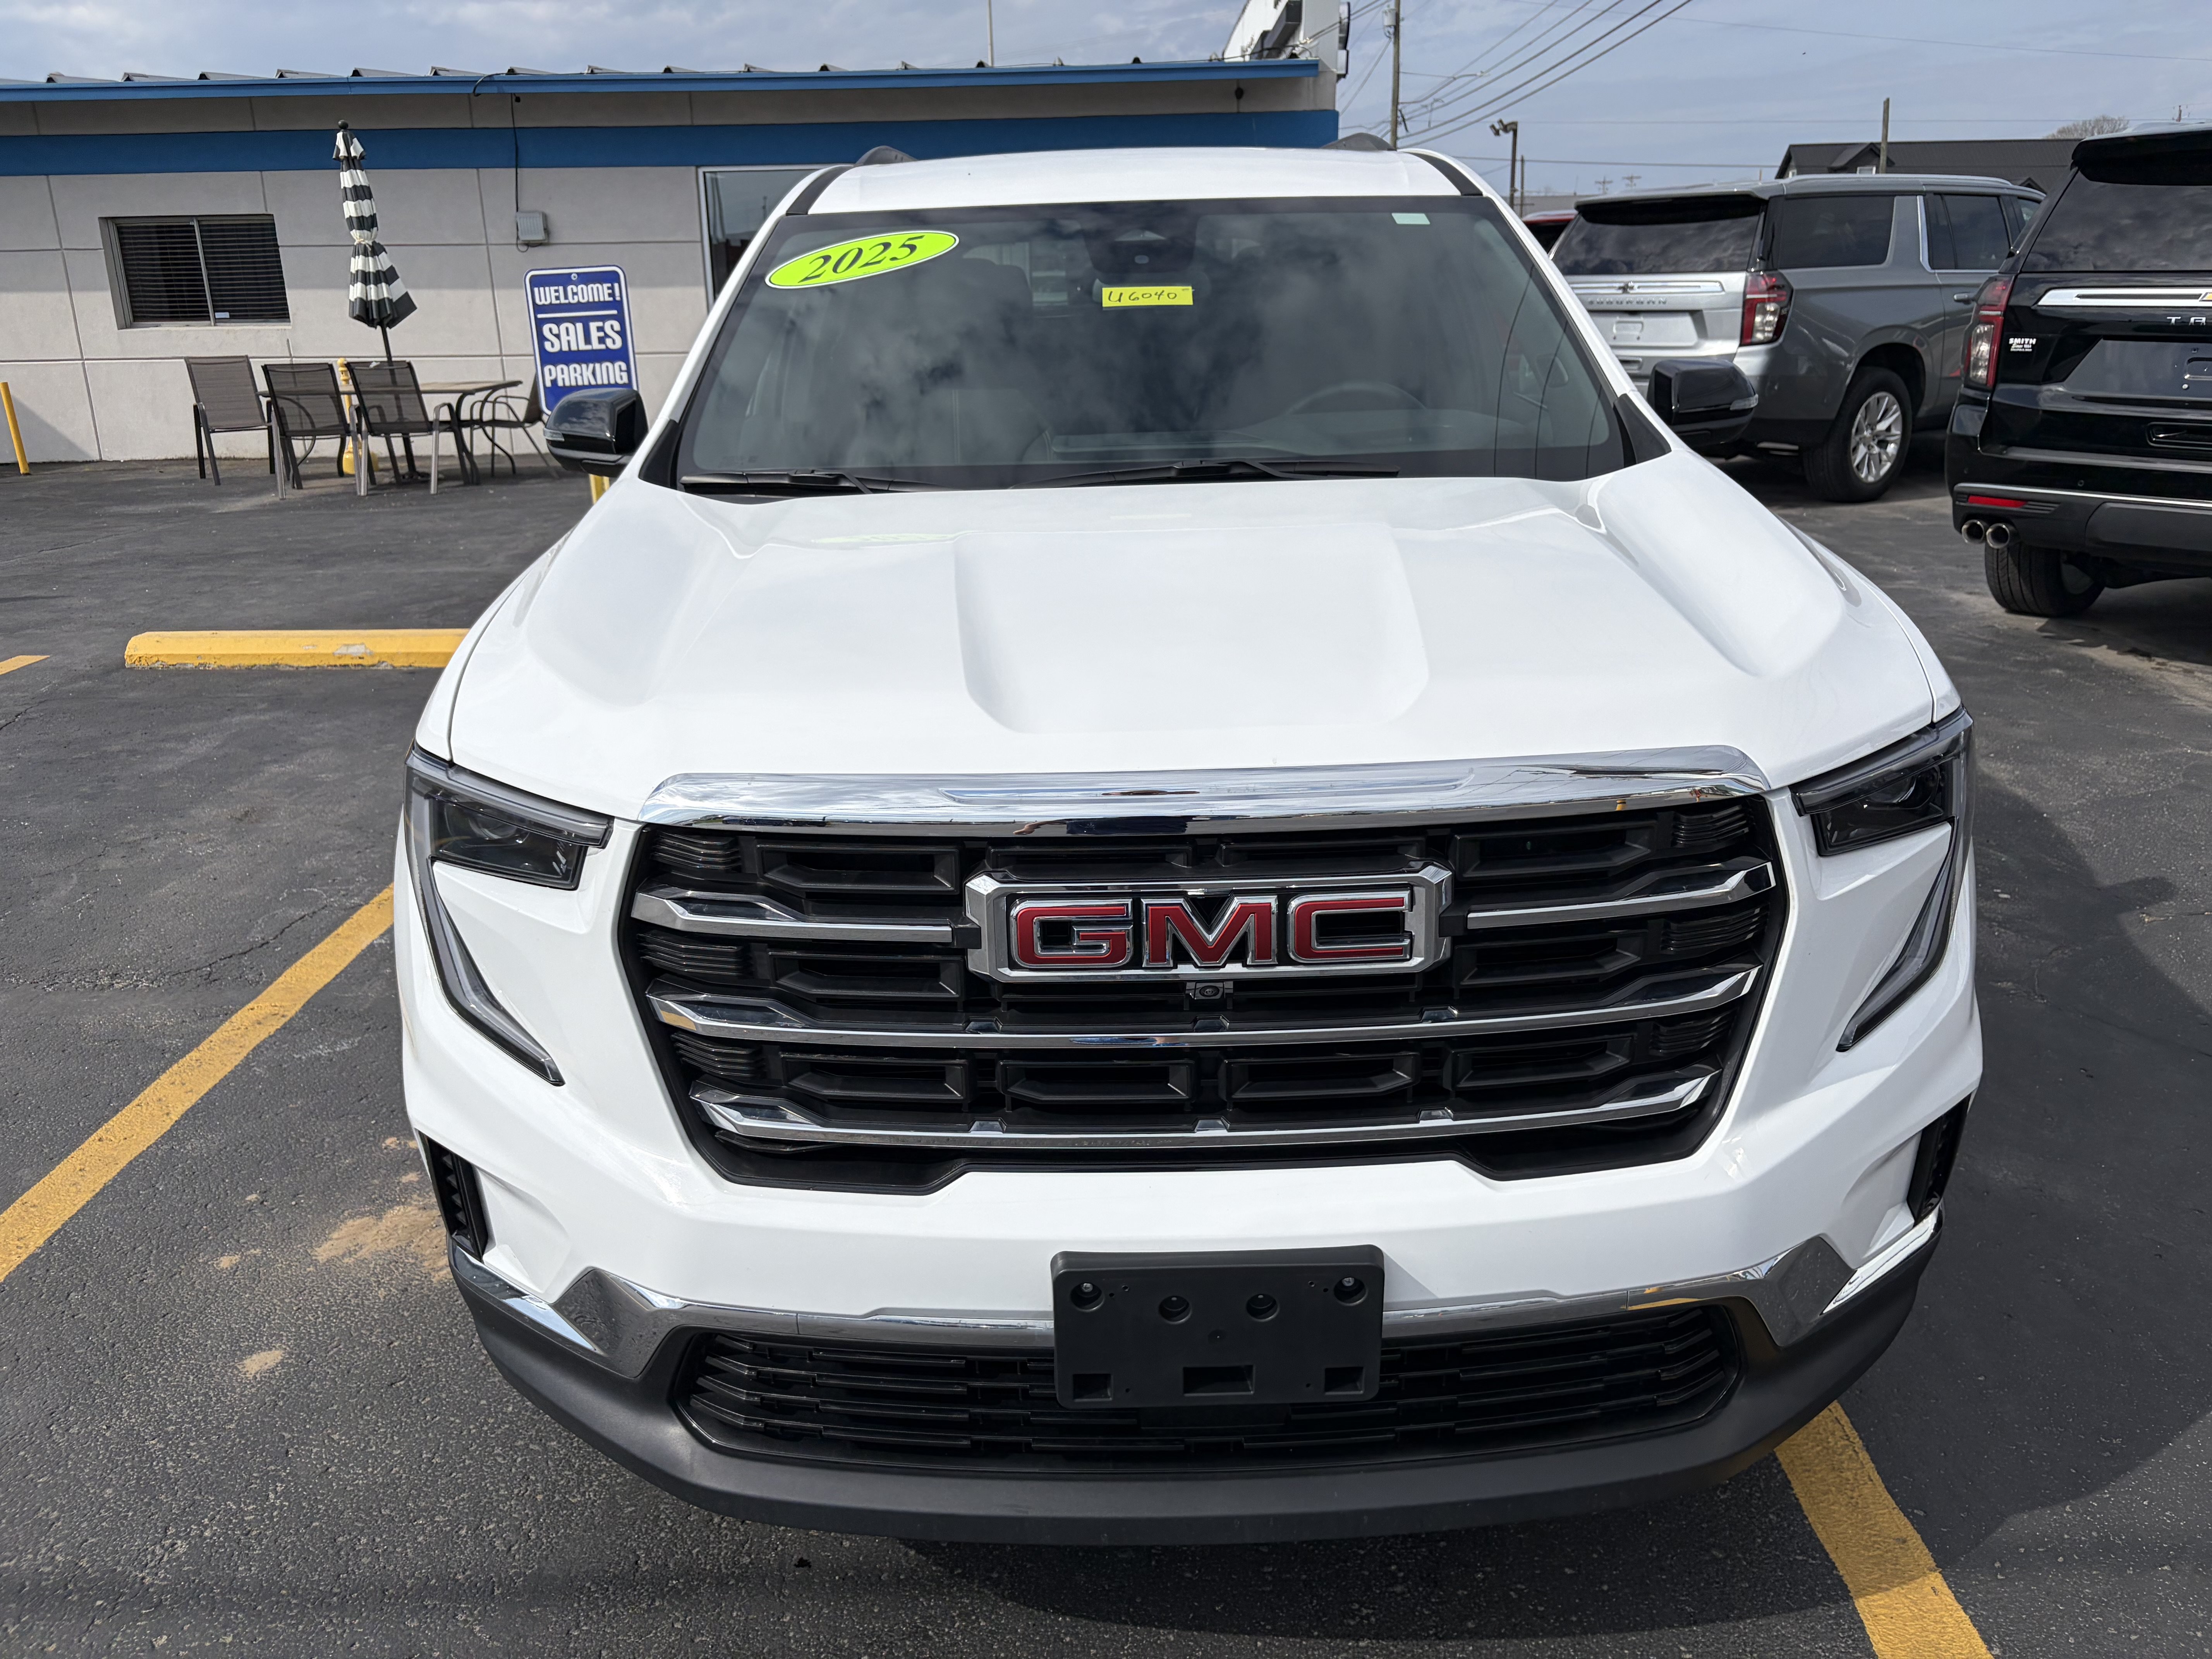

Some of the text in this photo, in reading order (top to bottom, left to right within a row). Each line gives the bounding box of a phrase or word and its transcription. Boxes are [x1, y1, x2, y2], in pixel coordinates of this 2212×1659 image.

[798, 235, 925, 283] 2025
[534, 283, 621, 305] WELCOME!
[543, 320, 622, 352] SALES
[544, 361, 629, 387] PARKING
[1010, 888, 1412, 968] GMC
